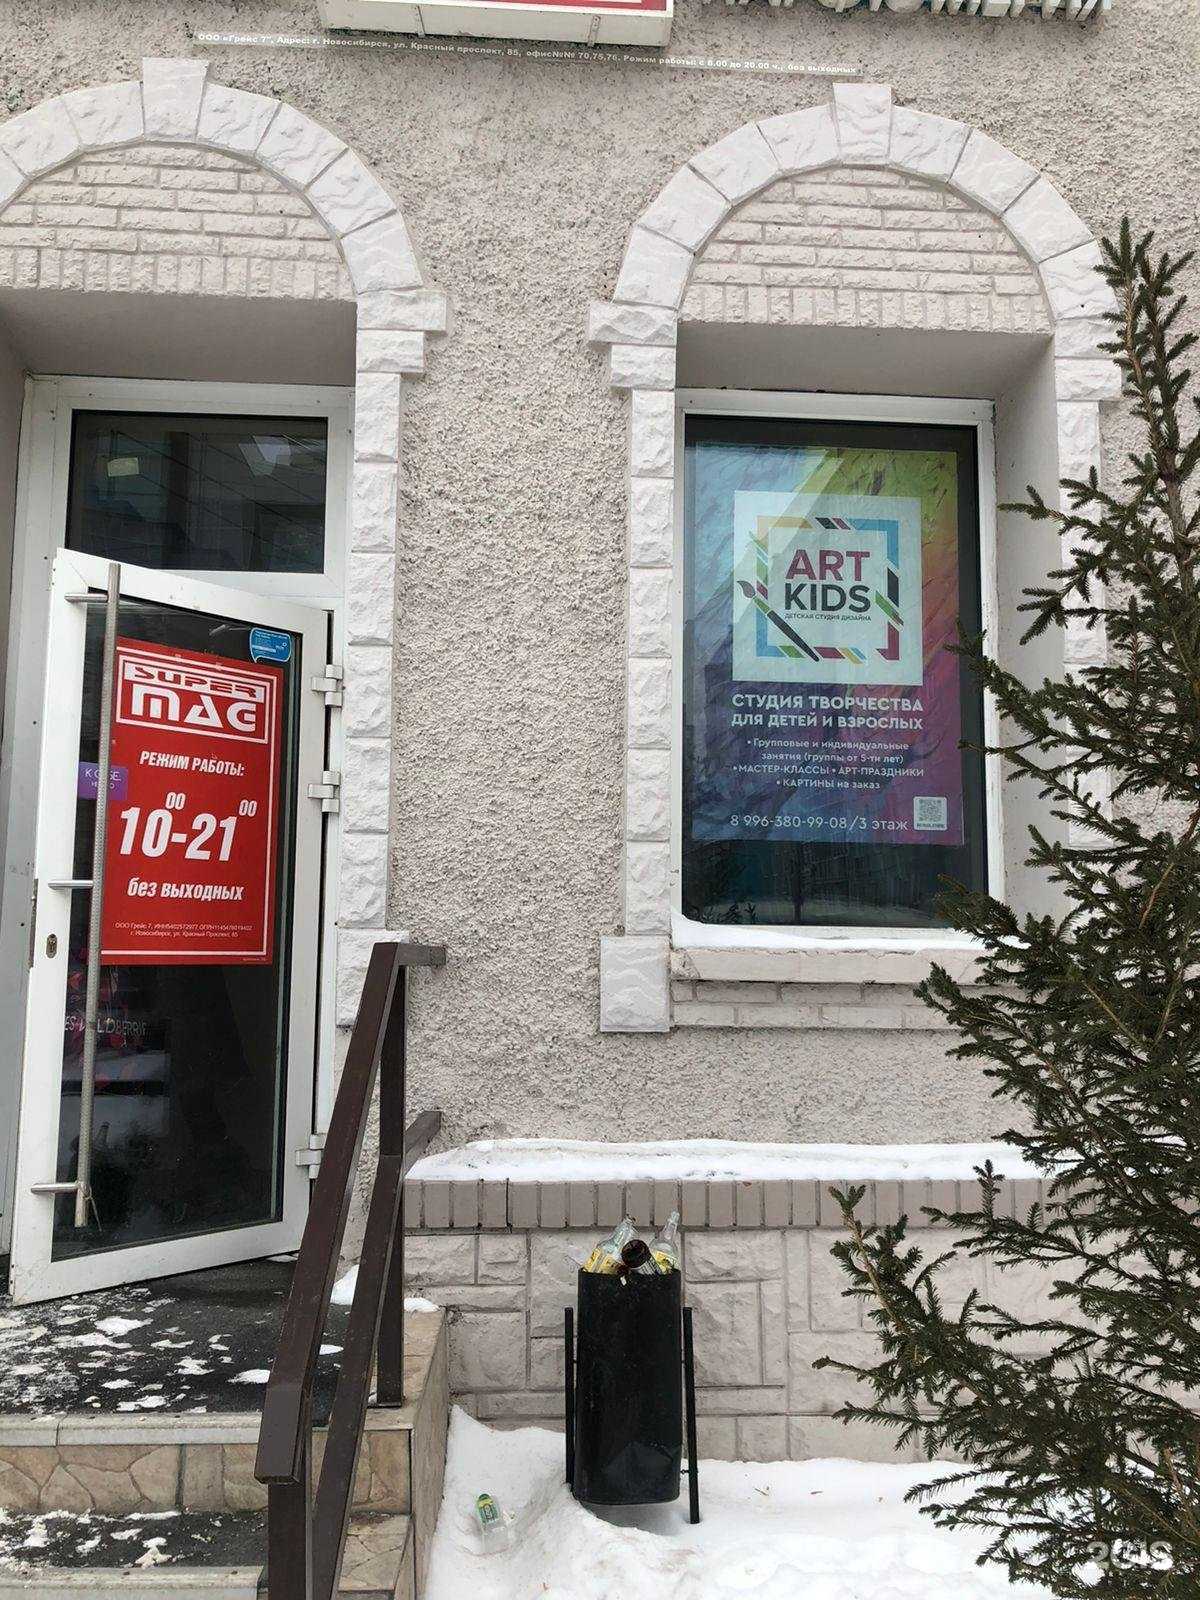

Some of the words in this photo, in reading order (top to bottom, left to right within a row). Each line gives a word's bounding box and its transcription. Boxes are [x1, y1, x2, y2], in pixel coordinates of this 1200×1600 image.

[198, 33, 220, 41] ООО
[411, 41, 454, 52] Красный
[623, 54, 656, 63] Режим
[659, 56, 697, 66] работы:
[729, 61, 742, 69] до
[744, 61, 769, 70] 20.00
[788, 63, 805, 71] без
[807, 64, 856, 73] выходных
[785, 549, 870, 581] ART
[784, 583, 871, 613] KIDS
[841, 614, 872, 622] ДИЗАЙНА
[130, 664, 259, 700] SUPER
[131, 683, 257, 732] MAG
[732, 693, 803, 710] СТУДИЯ
[808, 695, 923, 711] ТВОРЧЕСТВА
[731, 713, 763, 727] ДЛЯ
[767, 712, 817, 728] ДЕТЕЙ
[823, 715, 833, 728] И
[837, 716, 923, 730] ВЗРОСЛЫХ
[753, 738, 809, 749] Групповые
[812, 740, 819, 748] и
[821, 741, 910, 751] индивидуальные
[139, 750, 190, 770] РЕЖИМ
[191, 757, 245, 777] РАБОТЫ:
[761, 752, 801, 761] занятия
[804, 752, 844, 763] (группы
[847, 754, 858, 762] от
[860, 754, 881, 763] 5-ти
[883, 754, 903, 764] лет)
[738, 764, 829, 775] МАСТЕР-КЛАССЫ
[838, 766, 924, 777] АРТ-ПРАЗДНИКИ
[783, 778, 834, 788] КАРТИНЫ
[837, 781, 849, 789] на
[852, 781, 881, 789] заказ
[730, 814, 739, 827] 8
[871, 819, 908, 831] этаж
[127, 877, 158, 898] без
[160, 881, 245, 901] выходных
